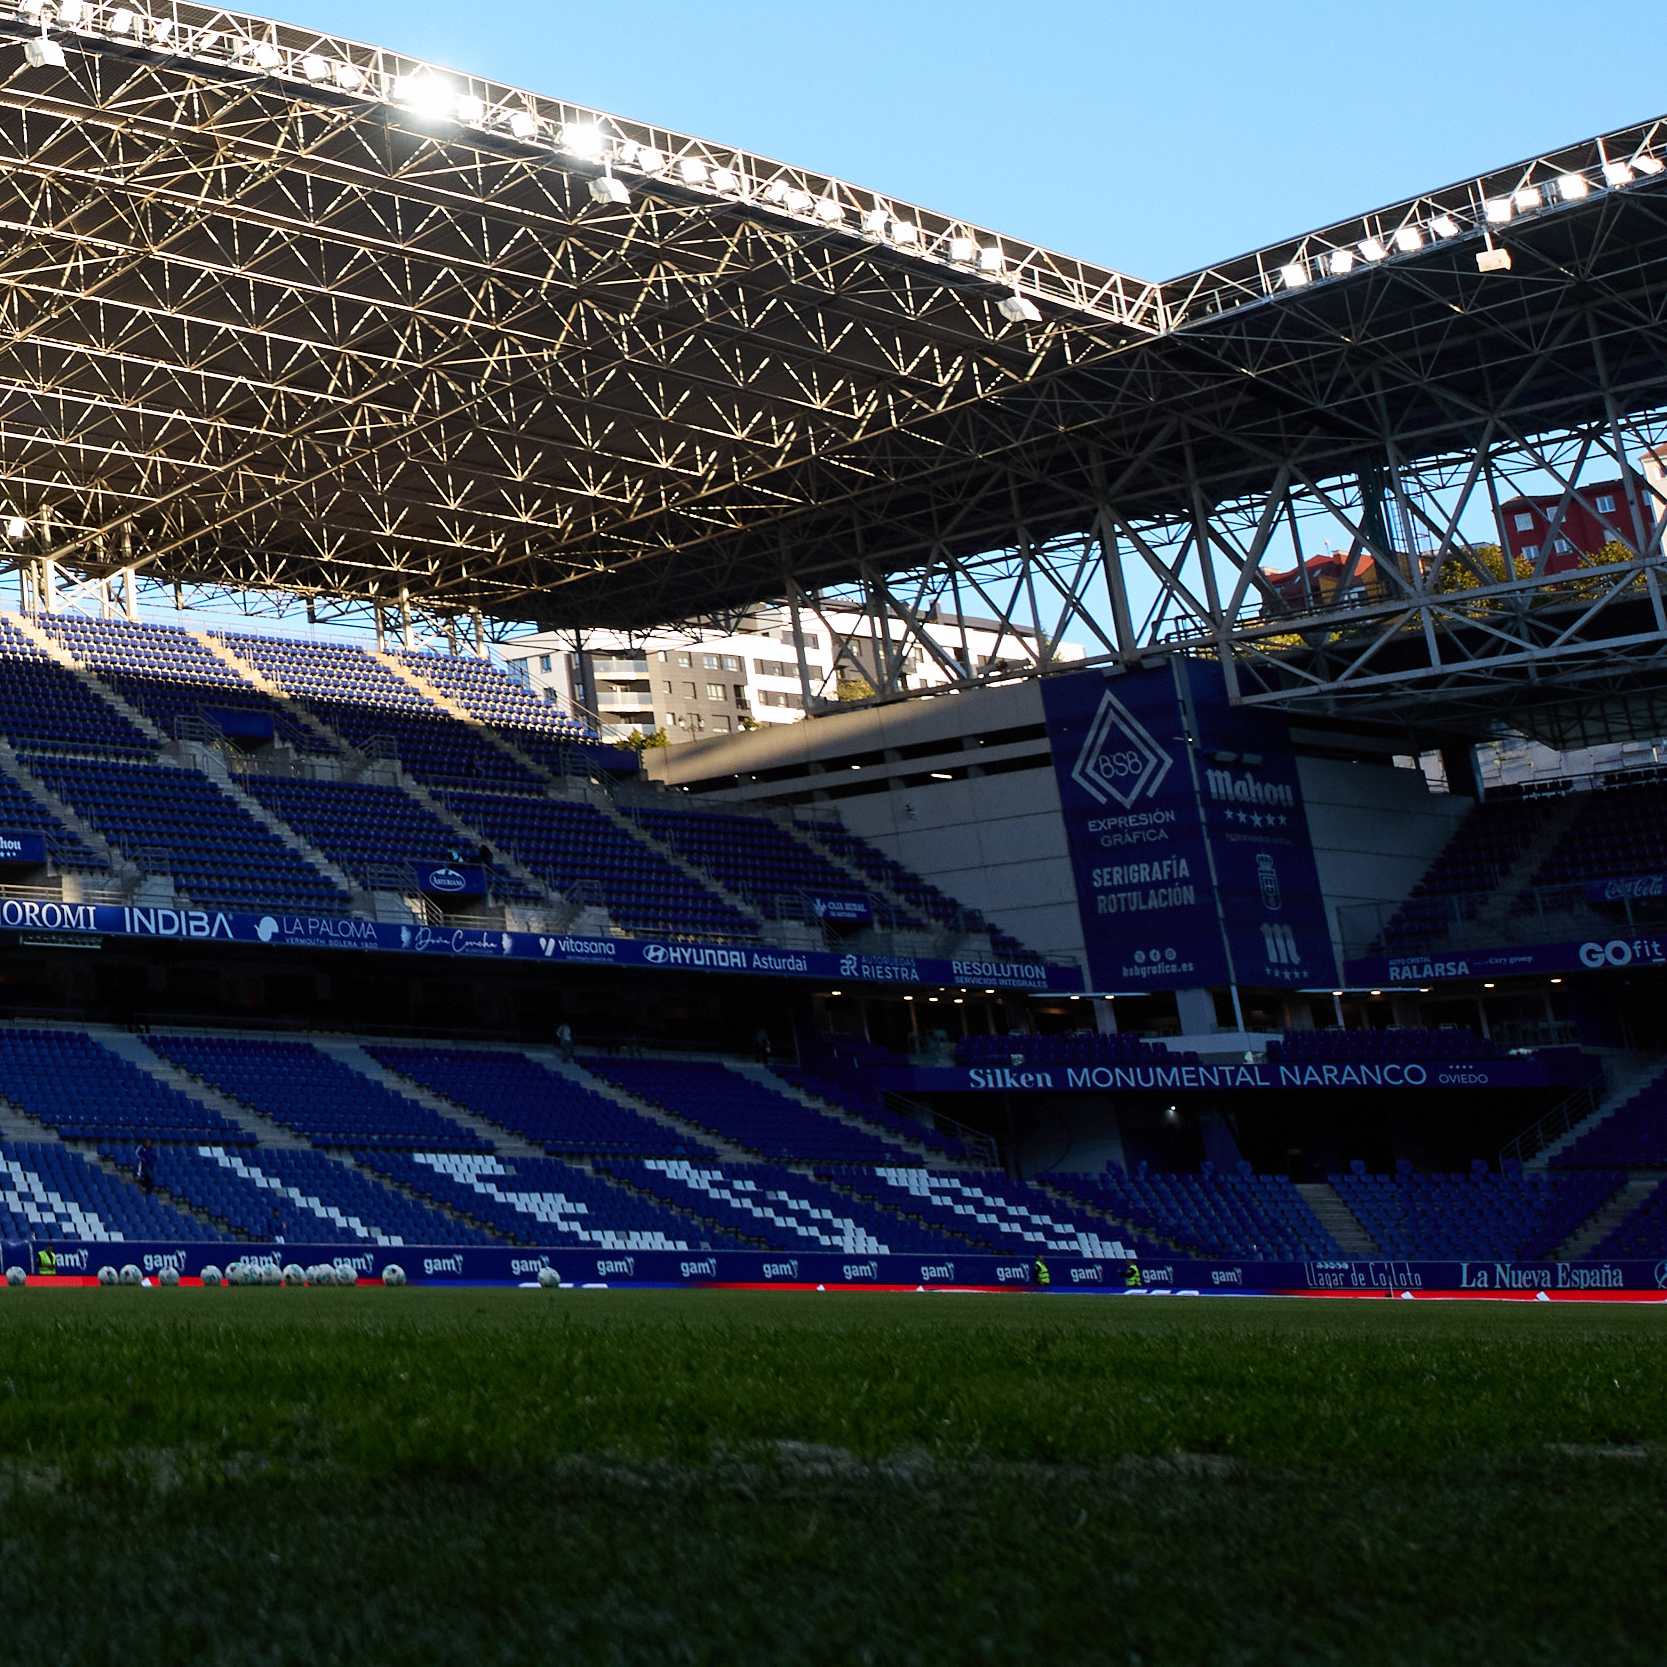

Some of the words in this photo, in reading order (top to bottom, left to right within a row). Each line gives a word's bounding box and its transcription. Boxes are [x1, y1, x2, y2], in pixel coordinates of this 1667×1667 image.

[1099, 750, 1142, 778] BSB
[1206, 768, 1295, 806] Mahou
[1087, 808, 1176, 832] EXPRESIÓN
[1100, 828, 1169, 847] GRÁFICA
[1092, 855, 1190, 887] SERIGRAFÍA
[1096, 882, 1195, 915] ROTULACIÓN
[283, 917, 304, 934] LA
[309, 919, 378, 939] PALOMA
[558, 937, 616, 955] vitasana
[668, 947, 747, 968] HYUNDAI
[752, 953, 808, 972] Asturdai
[952, 961, 1046, 980] RESOLUTION
[1122, 962, 1194, 978] bsbgrafica.es
[1389, 961, 1469, 981] RALARSA
[861, 965, 919, 981] RIESTRA
[955, 976, 997, 986] SERVICIOS
[998, 978, 1048, 988] INTEGRALES
[969, 1067, 1053, 1088] Silken
[1067, 1065, 1270, 1088] MONUMENTAL
[1279, 1064, 1427, 1085] NARANCO
[1438, 1073, 1489, 1084] OVIEDO
[1351, 1262, 1366, 1286] de
[1460, 1262, 1488, 1288] La
[1494, 1263, 1552, 1289] Nueva
[1556, 1263, 1624, 1289] España
